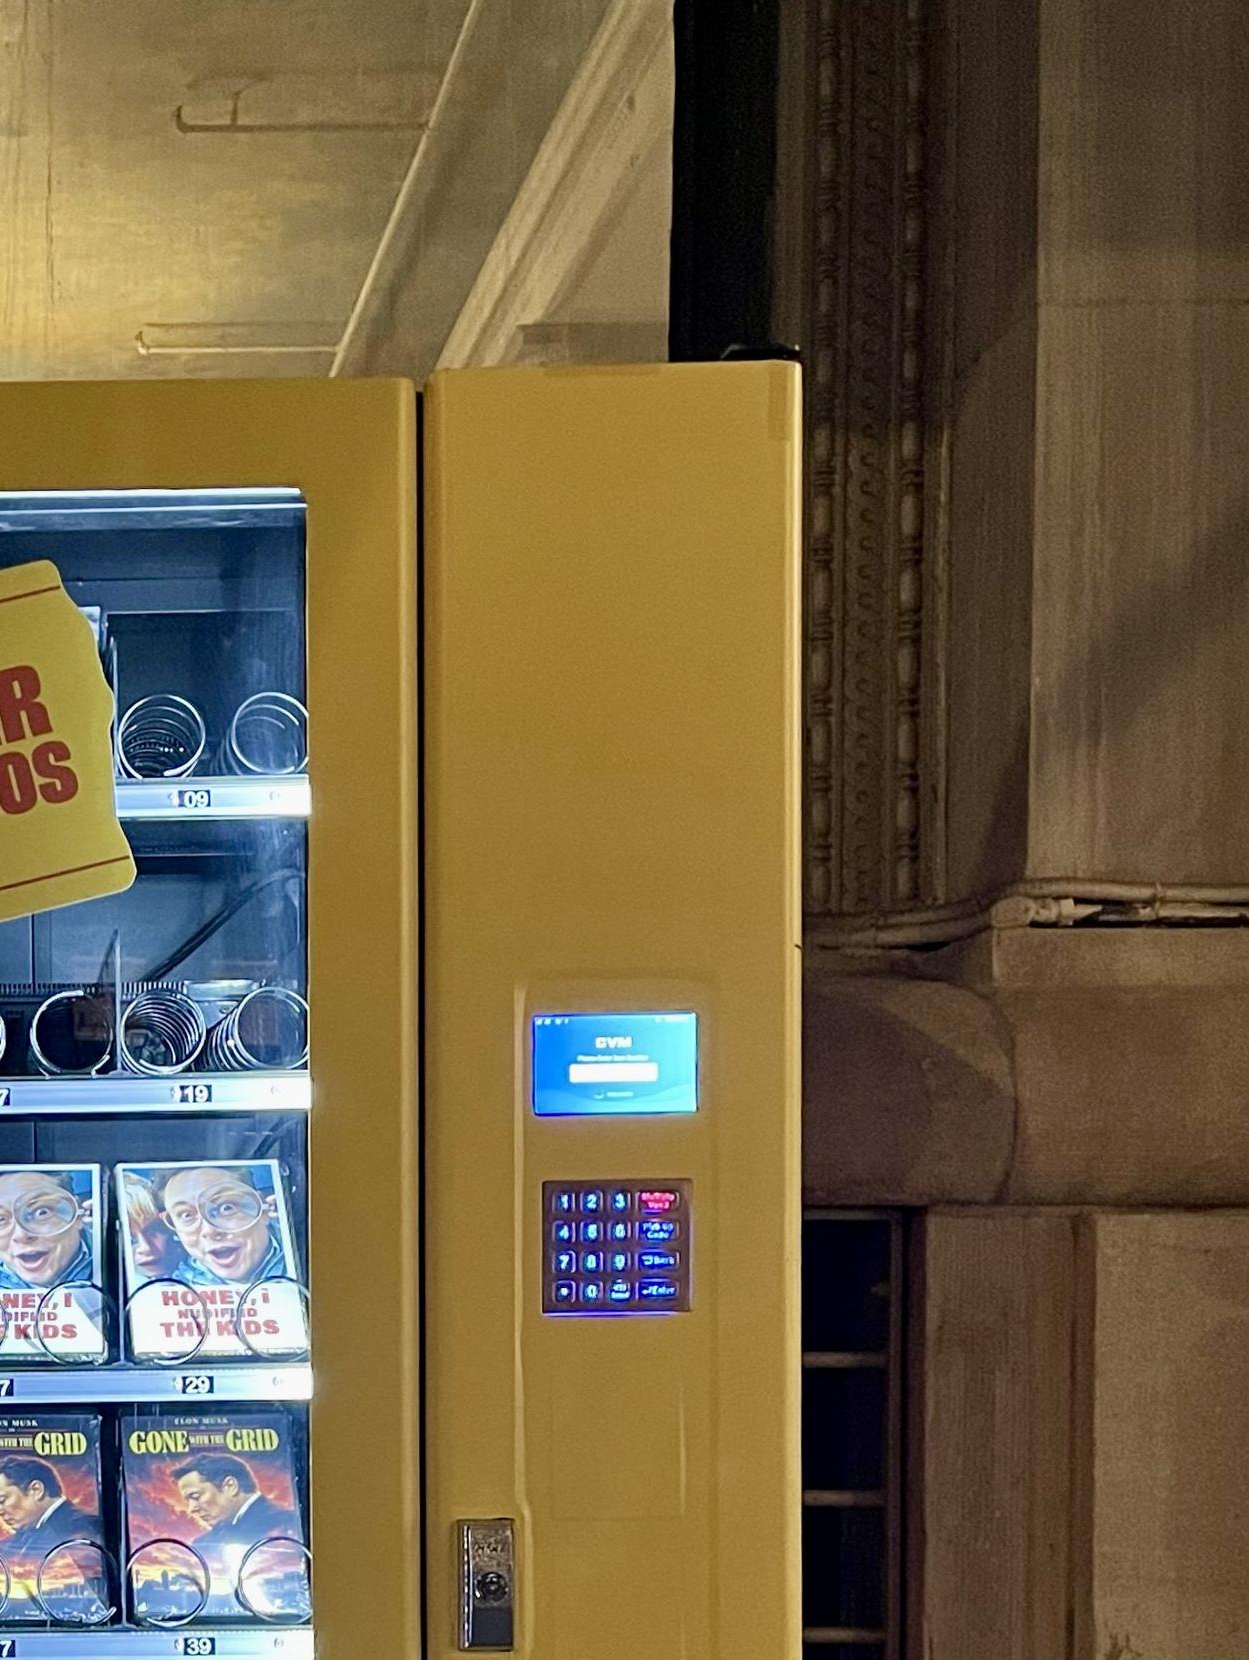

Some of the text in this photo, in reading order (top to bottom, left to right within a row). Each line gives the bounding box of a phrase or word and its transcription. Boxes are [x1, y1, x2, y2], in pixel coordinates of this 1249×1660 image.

[183, 791, 209, 808] 09
[184, 1085, 208, 1103] 19
[587, 1194, 597, 1209] 2
[559, 1255, 569, 1269] 7
[64, 1293, 72, 1307] I
[185, 1376, 210, 1394] 29
[34, 1431, 87, 1455] GRID
[129, 1430, 189, 1454] GONE
[225, 1428, 279, 1451] GRID
[187, 1637, 212, 1655] 39
